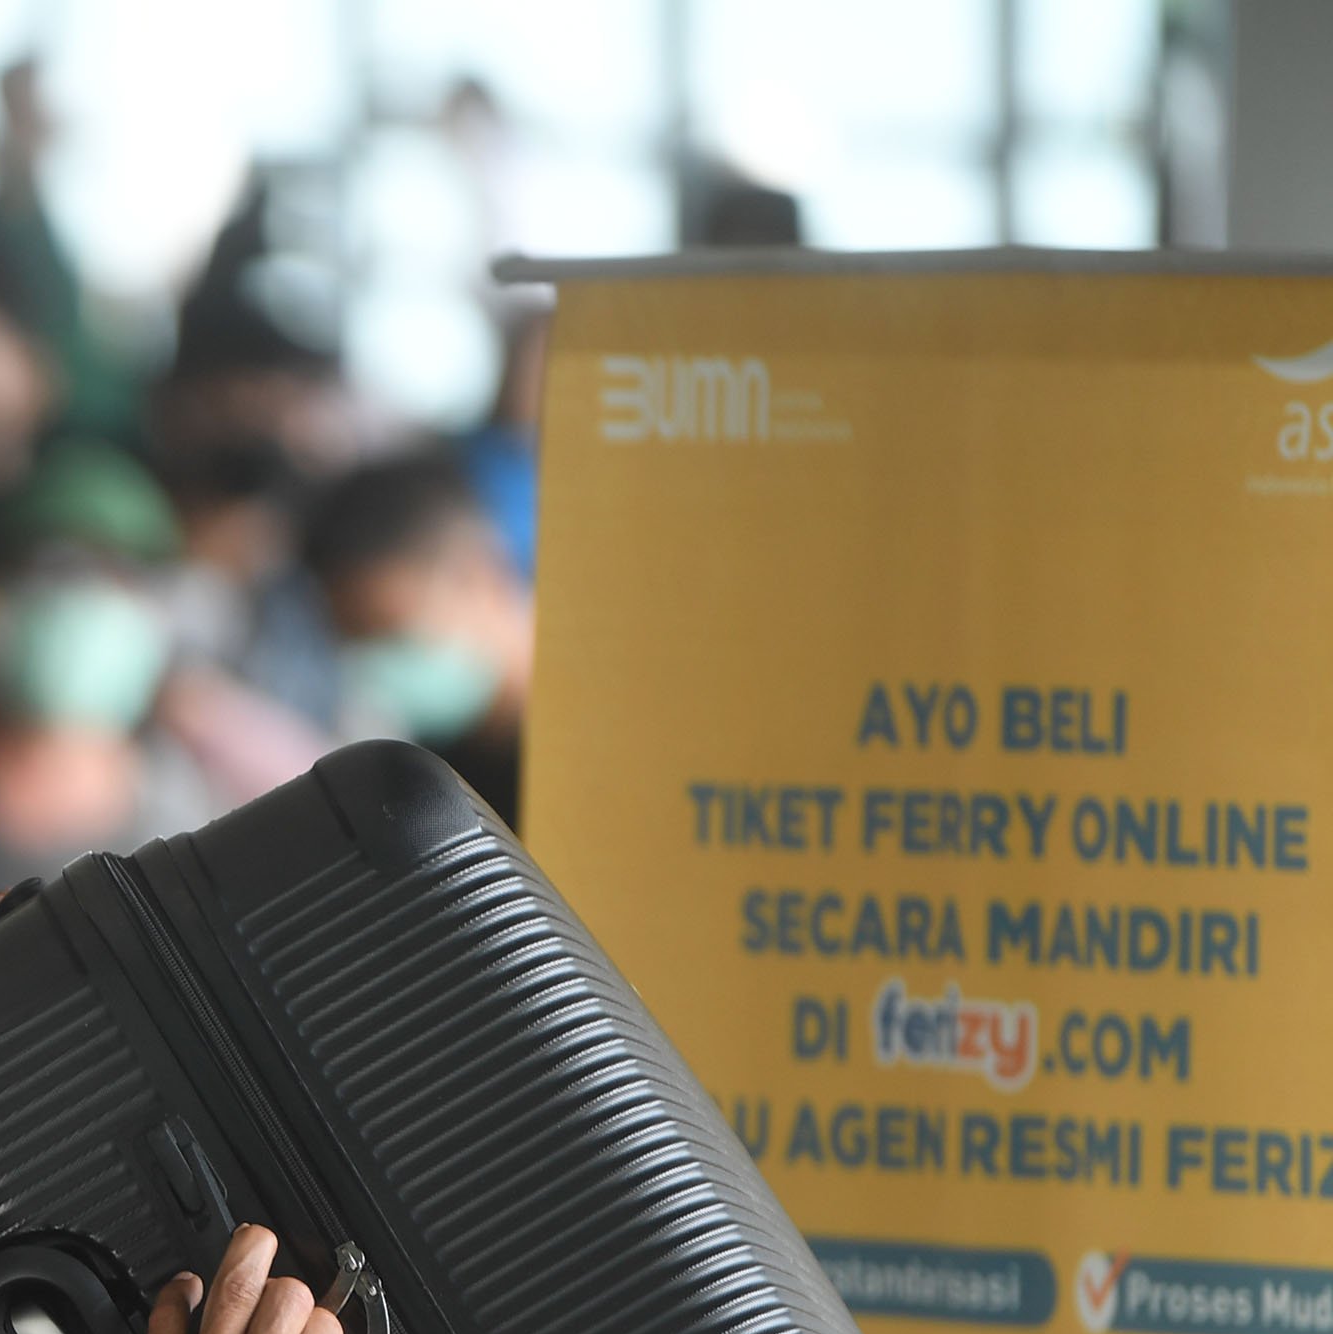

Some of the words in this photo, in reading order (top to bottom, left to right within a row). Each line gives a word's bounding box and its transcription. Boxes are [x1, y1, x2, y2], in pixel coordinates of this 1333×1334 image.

[857, 682, 980, 749] AYO
[1000, 689, 1128, 754] BELI
[688, 785, 842, 851] TIKET
[863, 790, 1057, 861] FERRY
[1072, 799, 1310, 871] ONLINE
[743, 891, 967, 963] SECARA
[986, 902, 1259, 977] MANDIRI
[794, 996, 848, 1062] DI
[789, 1101, 946, 1172] AGEN
[962, 1112, 1141, 1188] RESMI
[1125, 1271, 1253, 1324] Proses
